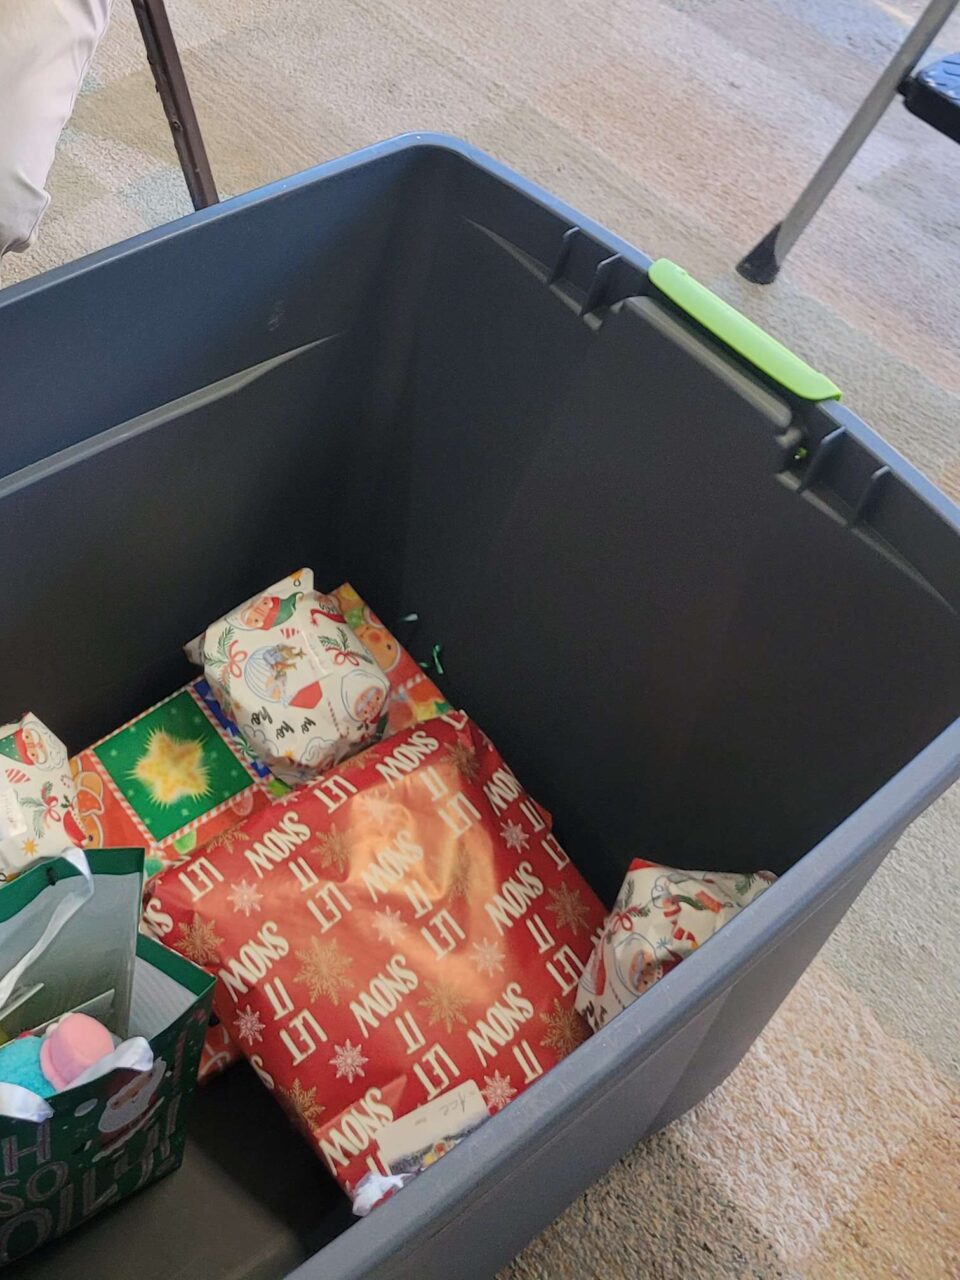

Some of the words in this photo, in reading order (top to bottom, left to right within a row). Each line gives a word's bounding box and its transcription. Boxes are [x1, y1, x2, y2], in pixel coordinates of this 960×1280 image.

[375, 730, 439, 789] SNOW
[419, 766, 448, 802] IT
[313, 774, 358, 814] LET
[438, 792, 482, 838] LET
[244, 811, 311, 878] SNOW
[361, 830, 425, 903] SNOW
[541, 833, 570, 870] ET
[178, 856, 225, 903] LET
[289, 856, 319, 892] IT
[405, 879, 434, 919] IT
[484, 861, 544, 936] SNOW
[306, 882, 353, 934] LET
[525, 913, 556, 954] IT
[420, 909, 466, 960] LET
[218, 920, 290, 1003] SNOW
[546, 944, 587, 997] LET
[264, 976, 294, 1021] IT
[349, 954, 419, 1039] SNOW
[279, 1008, 328, 1067] LET
[394, 1010, 426, 1055] IT
[466, 981, 535, 1069] SNOW
[412, 1042, 460, 1102] LET
[512, 1039, 544, 1085] IT
[318, 1087, 394, 1177] SNOW
